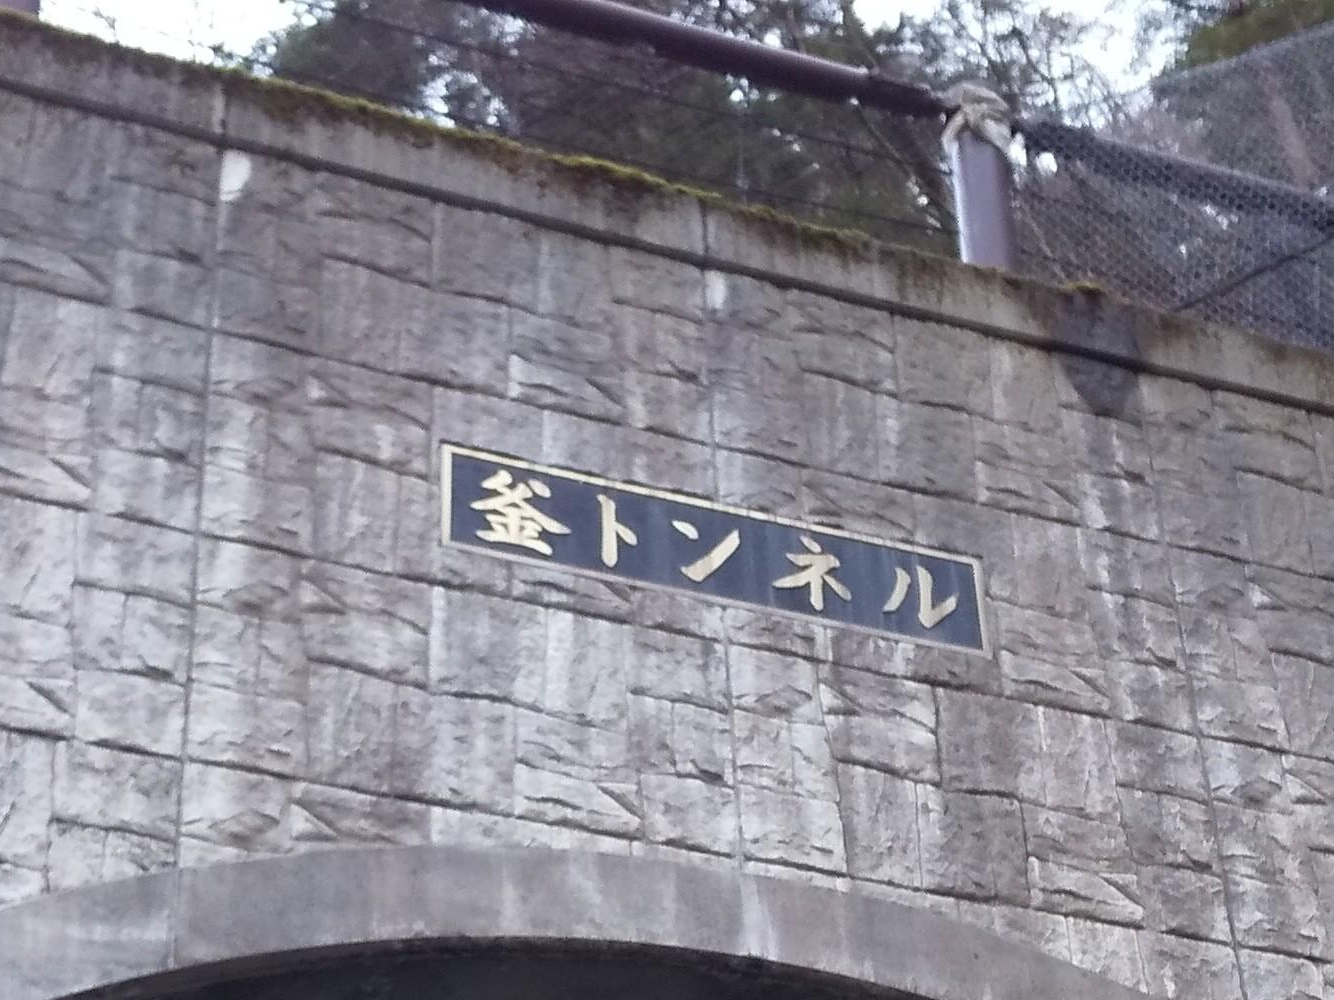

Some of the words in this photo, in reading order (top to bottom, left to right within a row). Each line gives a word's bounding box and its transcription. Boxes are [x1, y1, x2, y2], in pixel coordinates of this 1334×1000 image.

[470, 469, 958, 629] 釜トンネル
